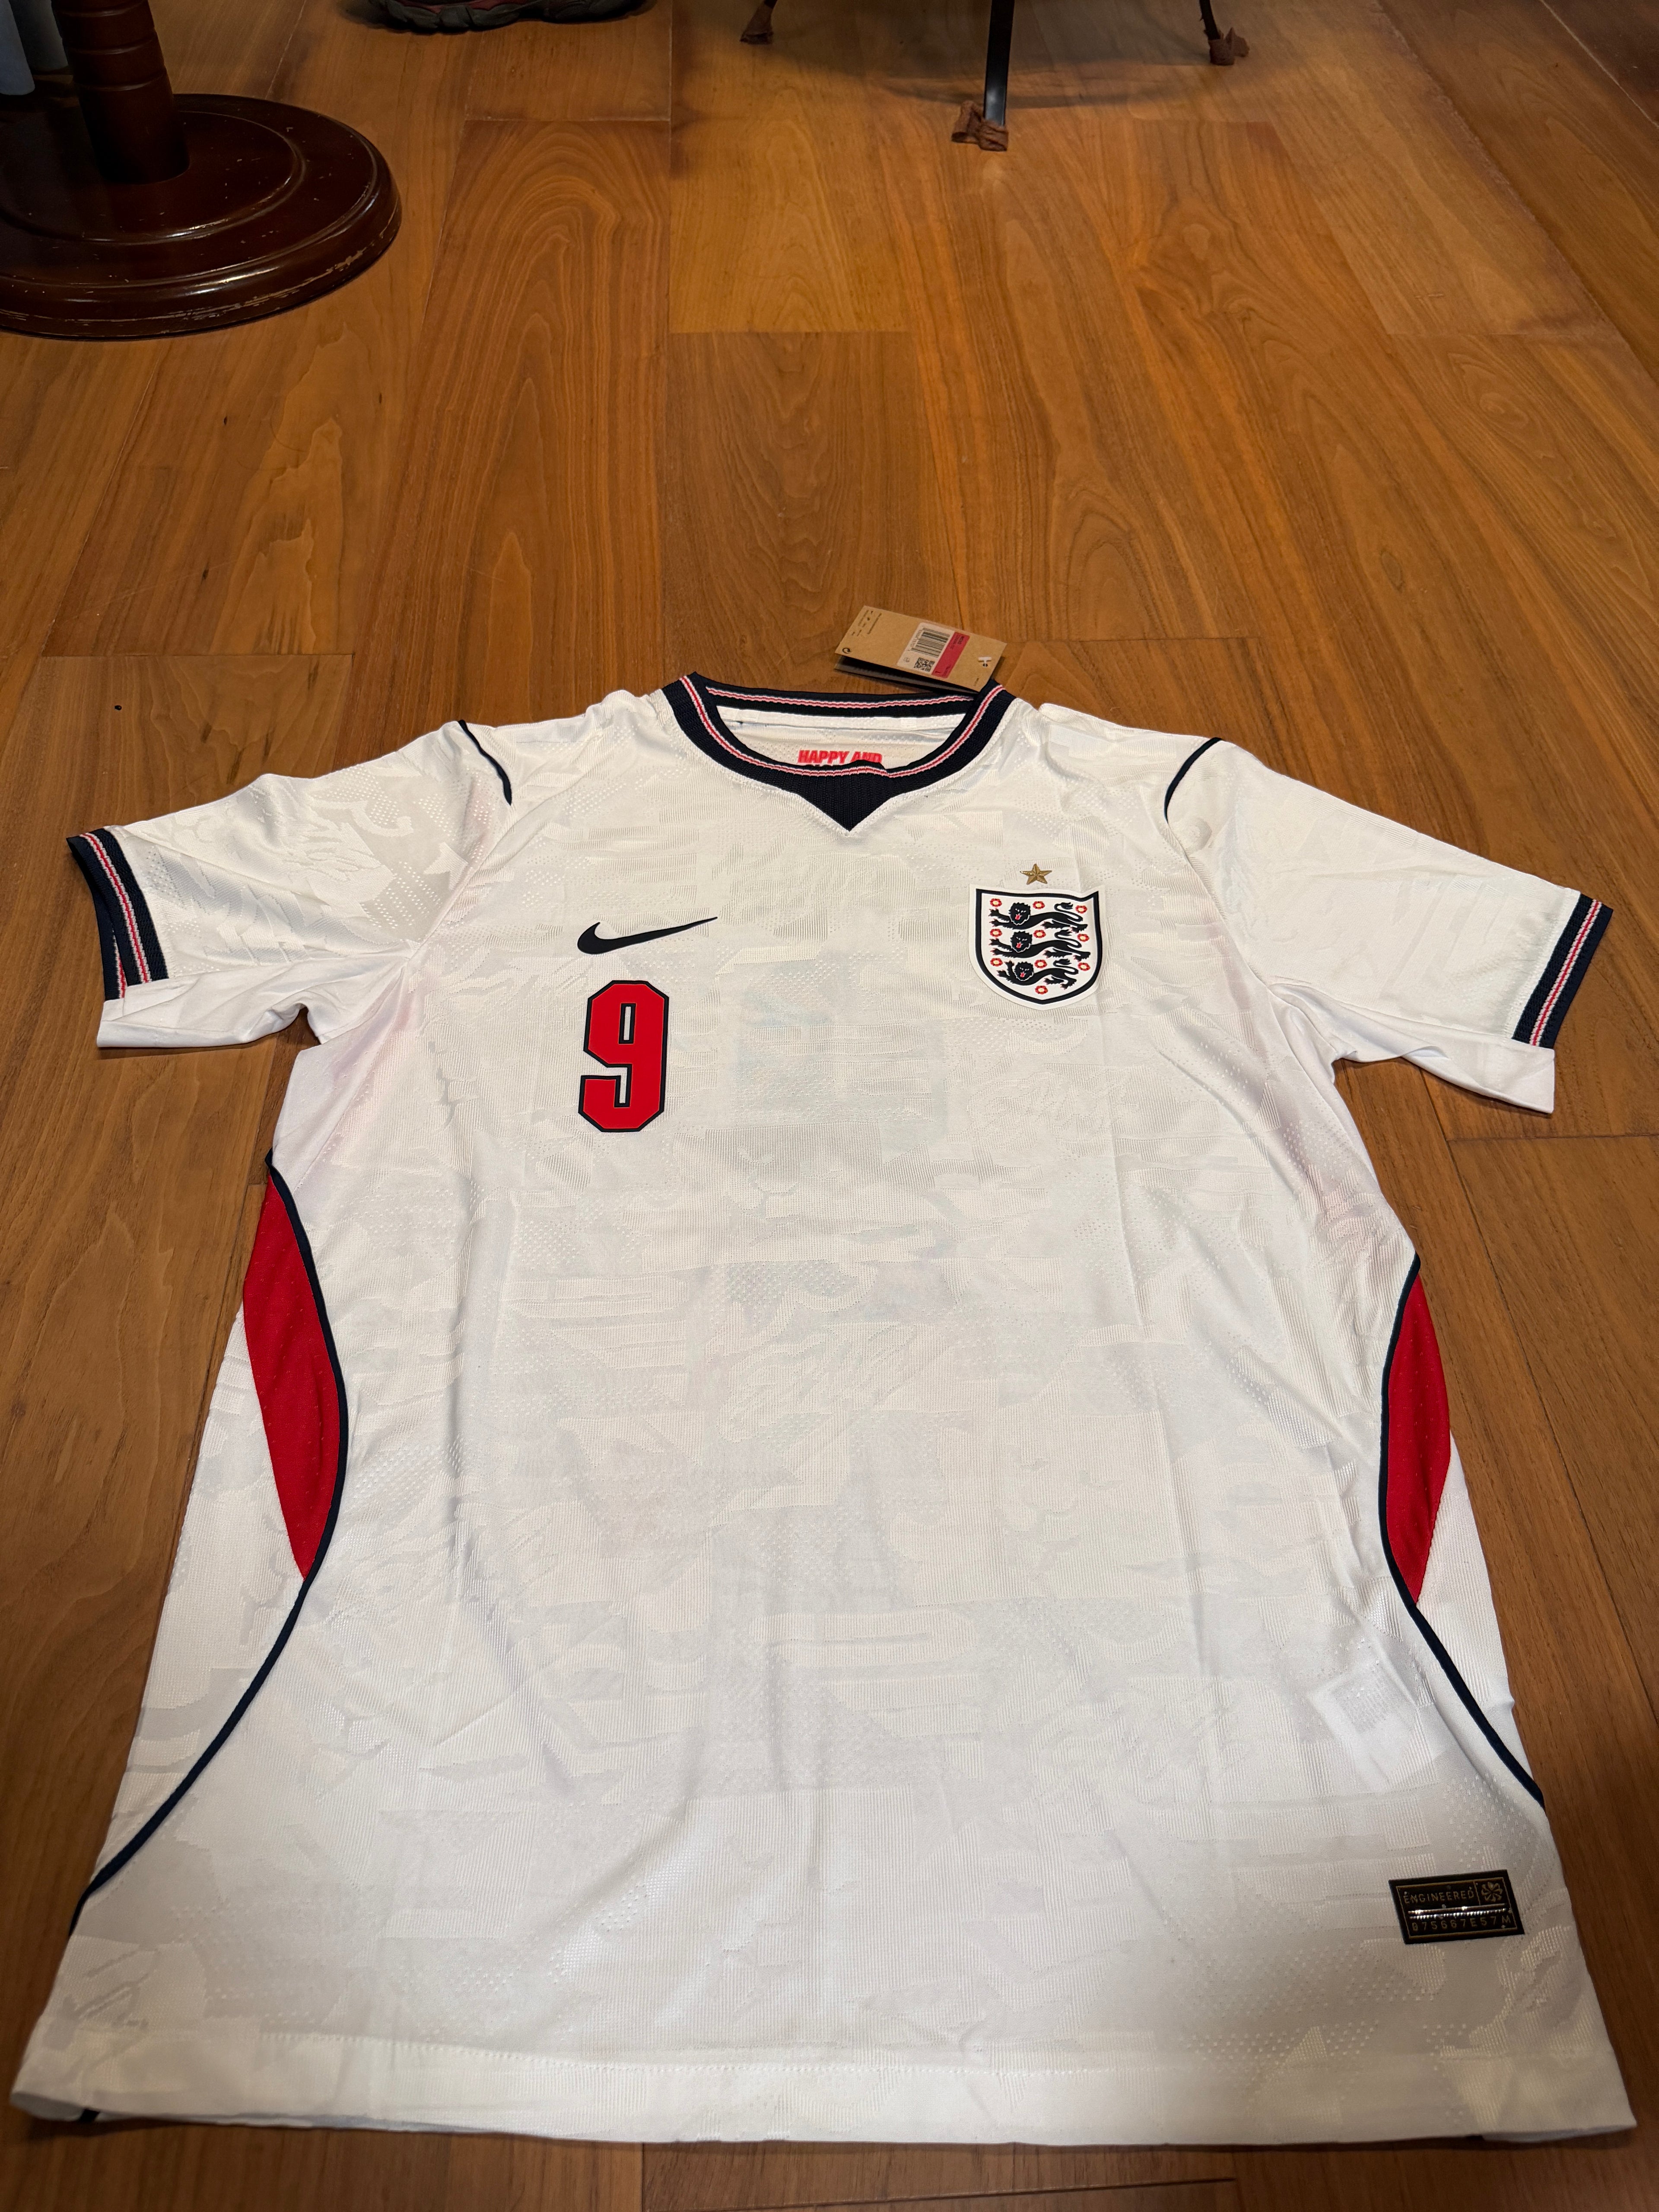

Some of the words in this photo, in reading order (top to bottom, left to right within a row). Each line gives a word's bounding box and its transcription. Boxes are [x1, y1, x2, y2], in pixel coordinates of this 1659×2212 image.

[798, 750, 849, 764] HAPPY
[850, 751, 883, 763] AND
[578, 980, 669, 1132] 9
[1403, 1890, 1474, 1904] ENGINEERED
